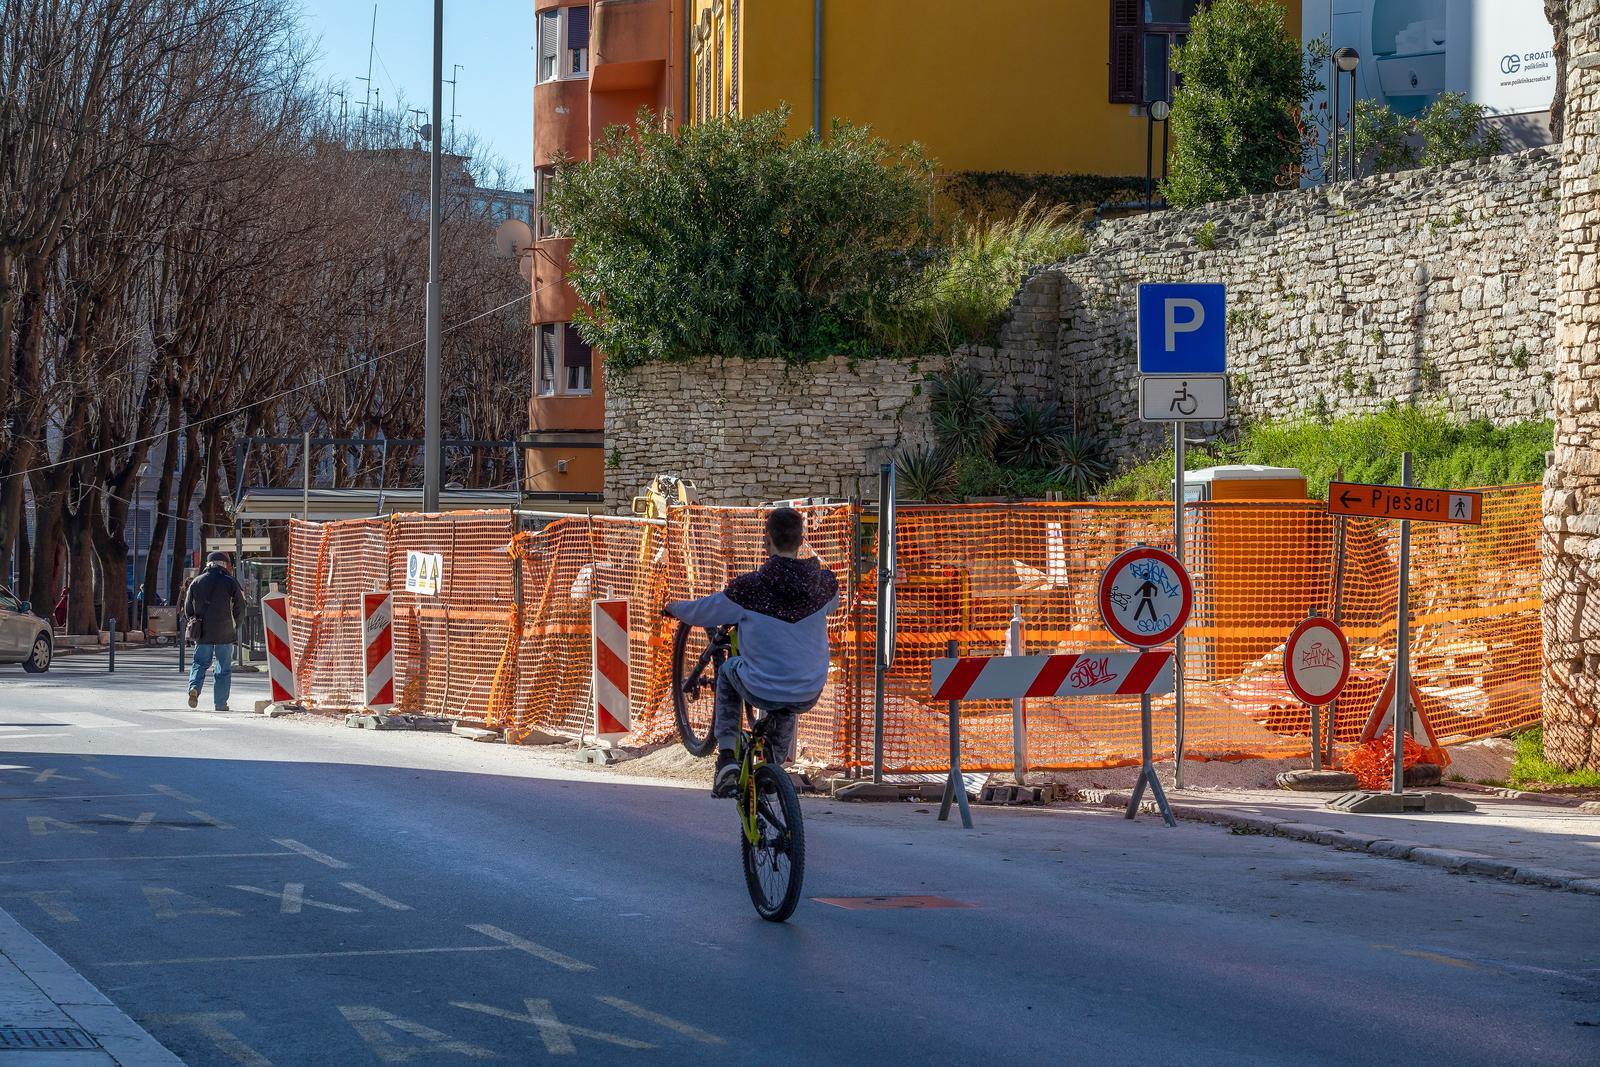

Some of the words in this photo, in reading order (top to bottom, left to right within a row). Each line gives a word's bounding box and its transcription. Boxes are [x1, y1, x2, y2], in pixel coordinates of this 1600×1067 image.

[1165, 298, 1205, 352] P
[1371, 489, 1440, 514] Pješaci
[142, 997, 729, 1067] TAXI
